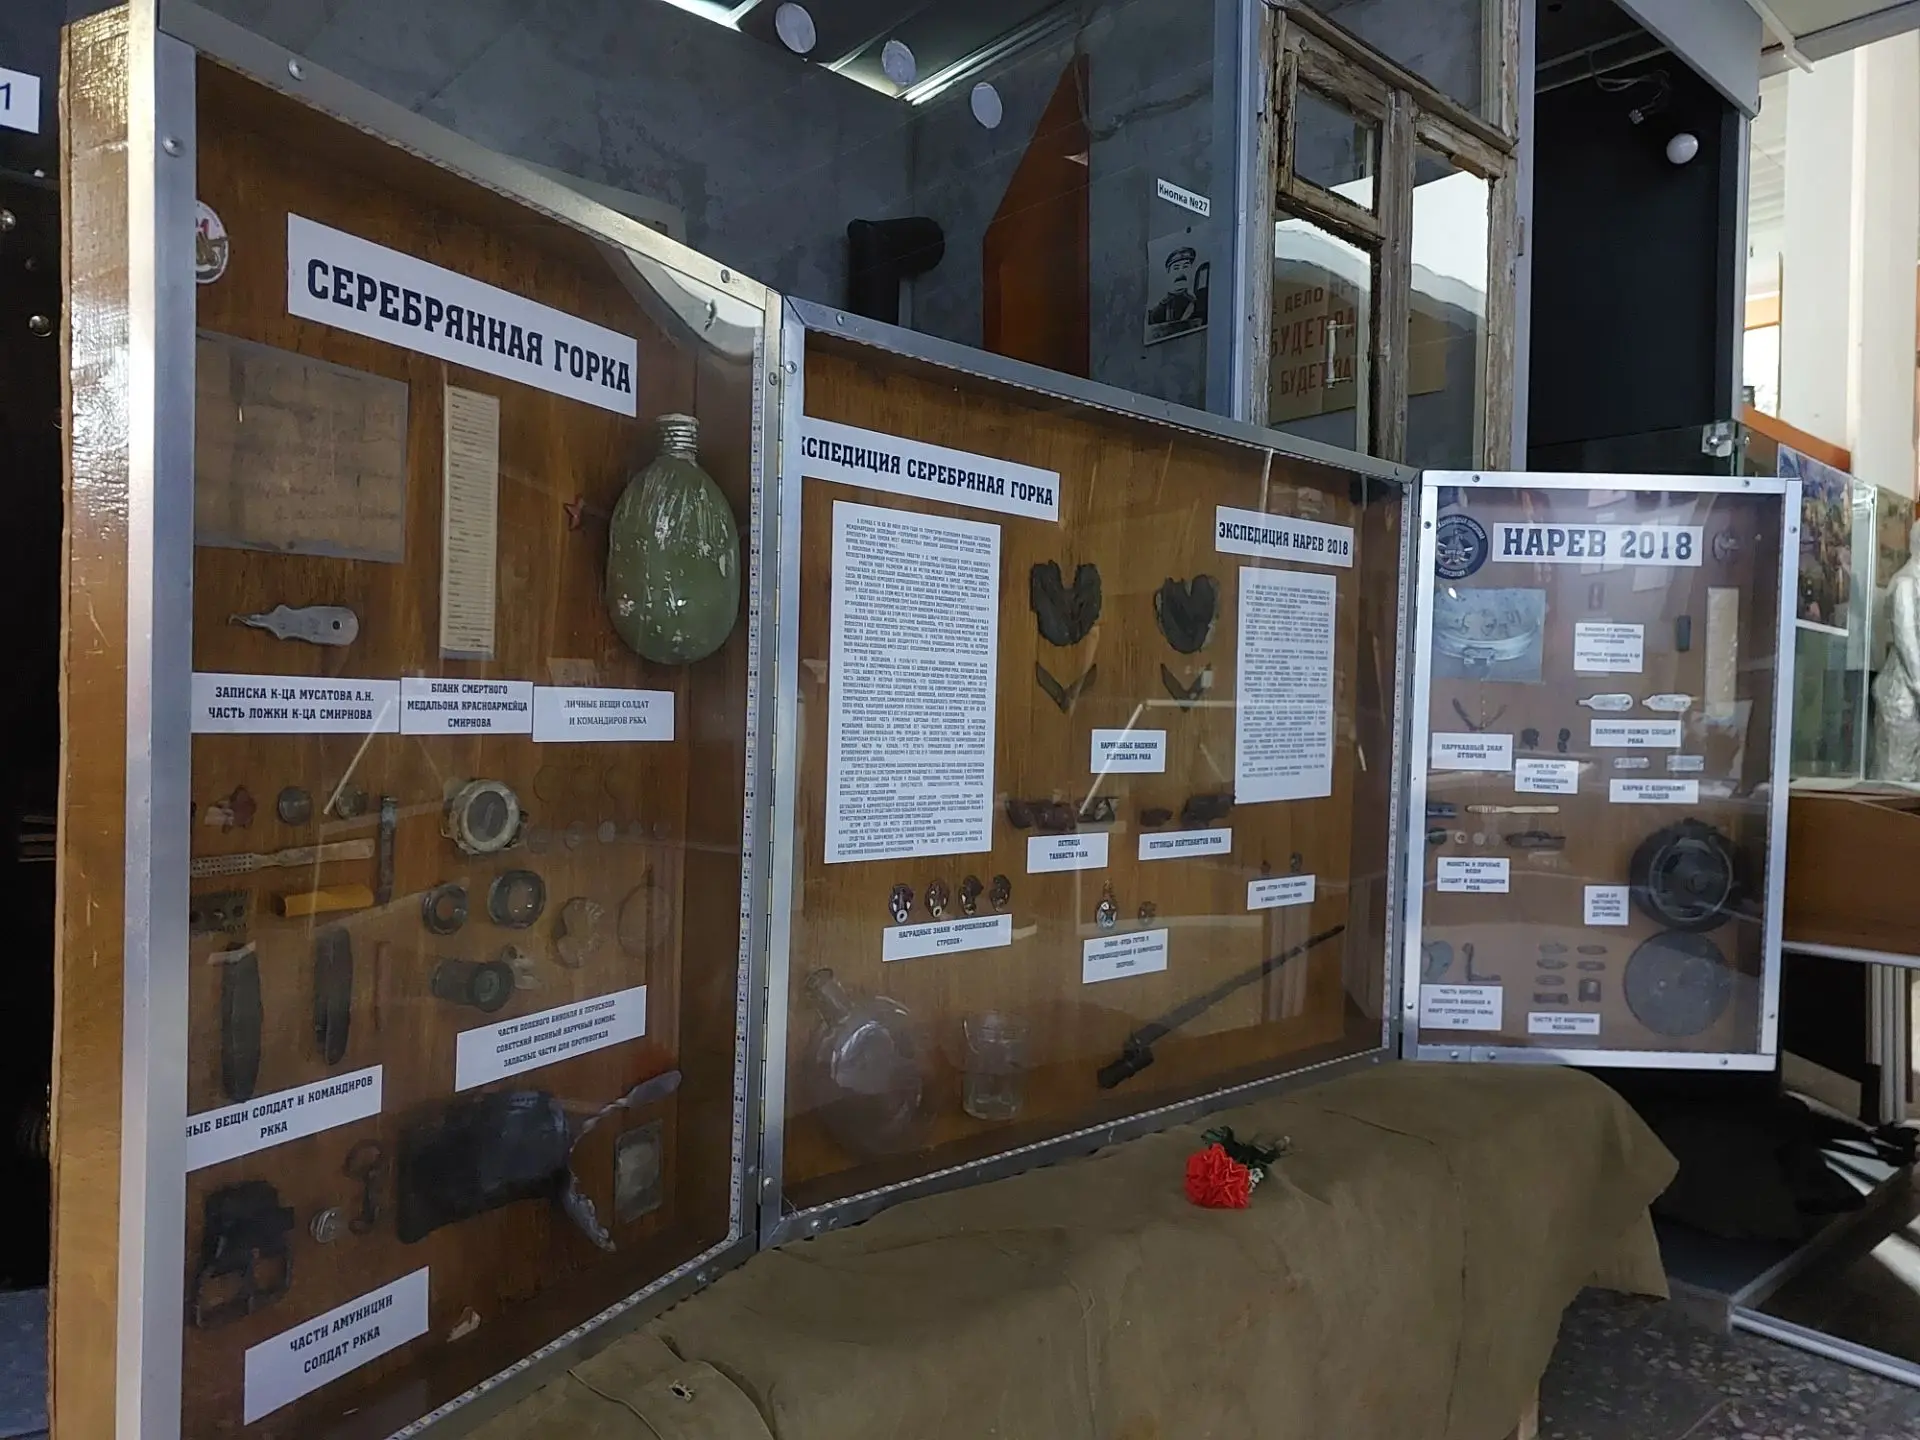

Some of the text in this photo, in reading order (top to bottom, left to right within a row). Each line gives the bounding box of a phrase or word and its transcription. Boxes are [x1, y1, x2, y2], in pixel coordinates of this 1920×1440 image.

[1159, 183, 1208, 212] Кнопка №27
[1284, 286, 1324, 314] ДЕЛО
[306, 258, 633, 395] СЕРЕБРЯННАЯ ГОРКА
[907, 458, 1005, 496] СЕРЕБРЯНАЯ
[1010, 480, 1054, 507] ГОРКА
[1218, 521, 1349, 556] ЭКСПЕДИЦИЯ НАРЕВ 2018
[1502, 527, 1607, 558] НАРЕВ
[1620, 529, 1693, 560] 2018
[215, 686, 267, 699] ЗАПИСКА
[271, 688, 296, 701] К-ЦА
[299, 689, 353, 702] МУСАТОВА
[431, 683, 508, 695] БЛАНК СМЕРТНОГО
[208, 706, 373, 721] ЧАСТЬ ЛОЖКИ К-ЦА СМИРНОВА
[407, 700, 528, 712] МЕДАЛЬОНА КРАСНОАРМЕЙЦА
[563, 699, 597, 709] ЛИЧНЫЕ
[621, 700, 649, 710] СОЛДАТ
[447, 718, 492, 728] СМИРНОВА
[576, 716, 628, 727] КОМАНДИРОВ
[497, 1026, 519, 1037] ЧАСТИ
[496, 1036, 532, 1054] СОВЕТСКИЙ
[503, 1051, 537, 1068] ЗАПАСНЫЕ
[215, 1110, 249, 1130] ВЕЩИ
[252, 1097, 295, 1119] СОЛДАТ
[297, 1095, 305, 1106] И
[307, 1075, 373, 1103] КОМАНДИРОВ
[259, 1121, 288, 1139] РККА
[289, 1294, 393, 1352] ЧАСТИ АМУНИЦИИ
[303, 1325, 381, 1374] СОЛДАТ РККА
